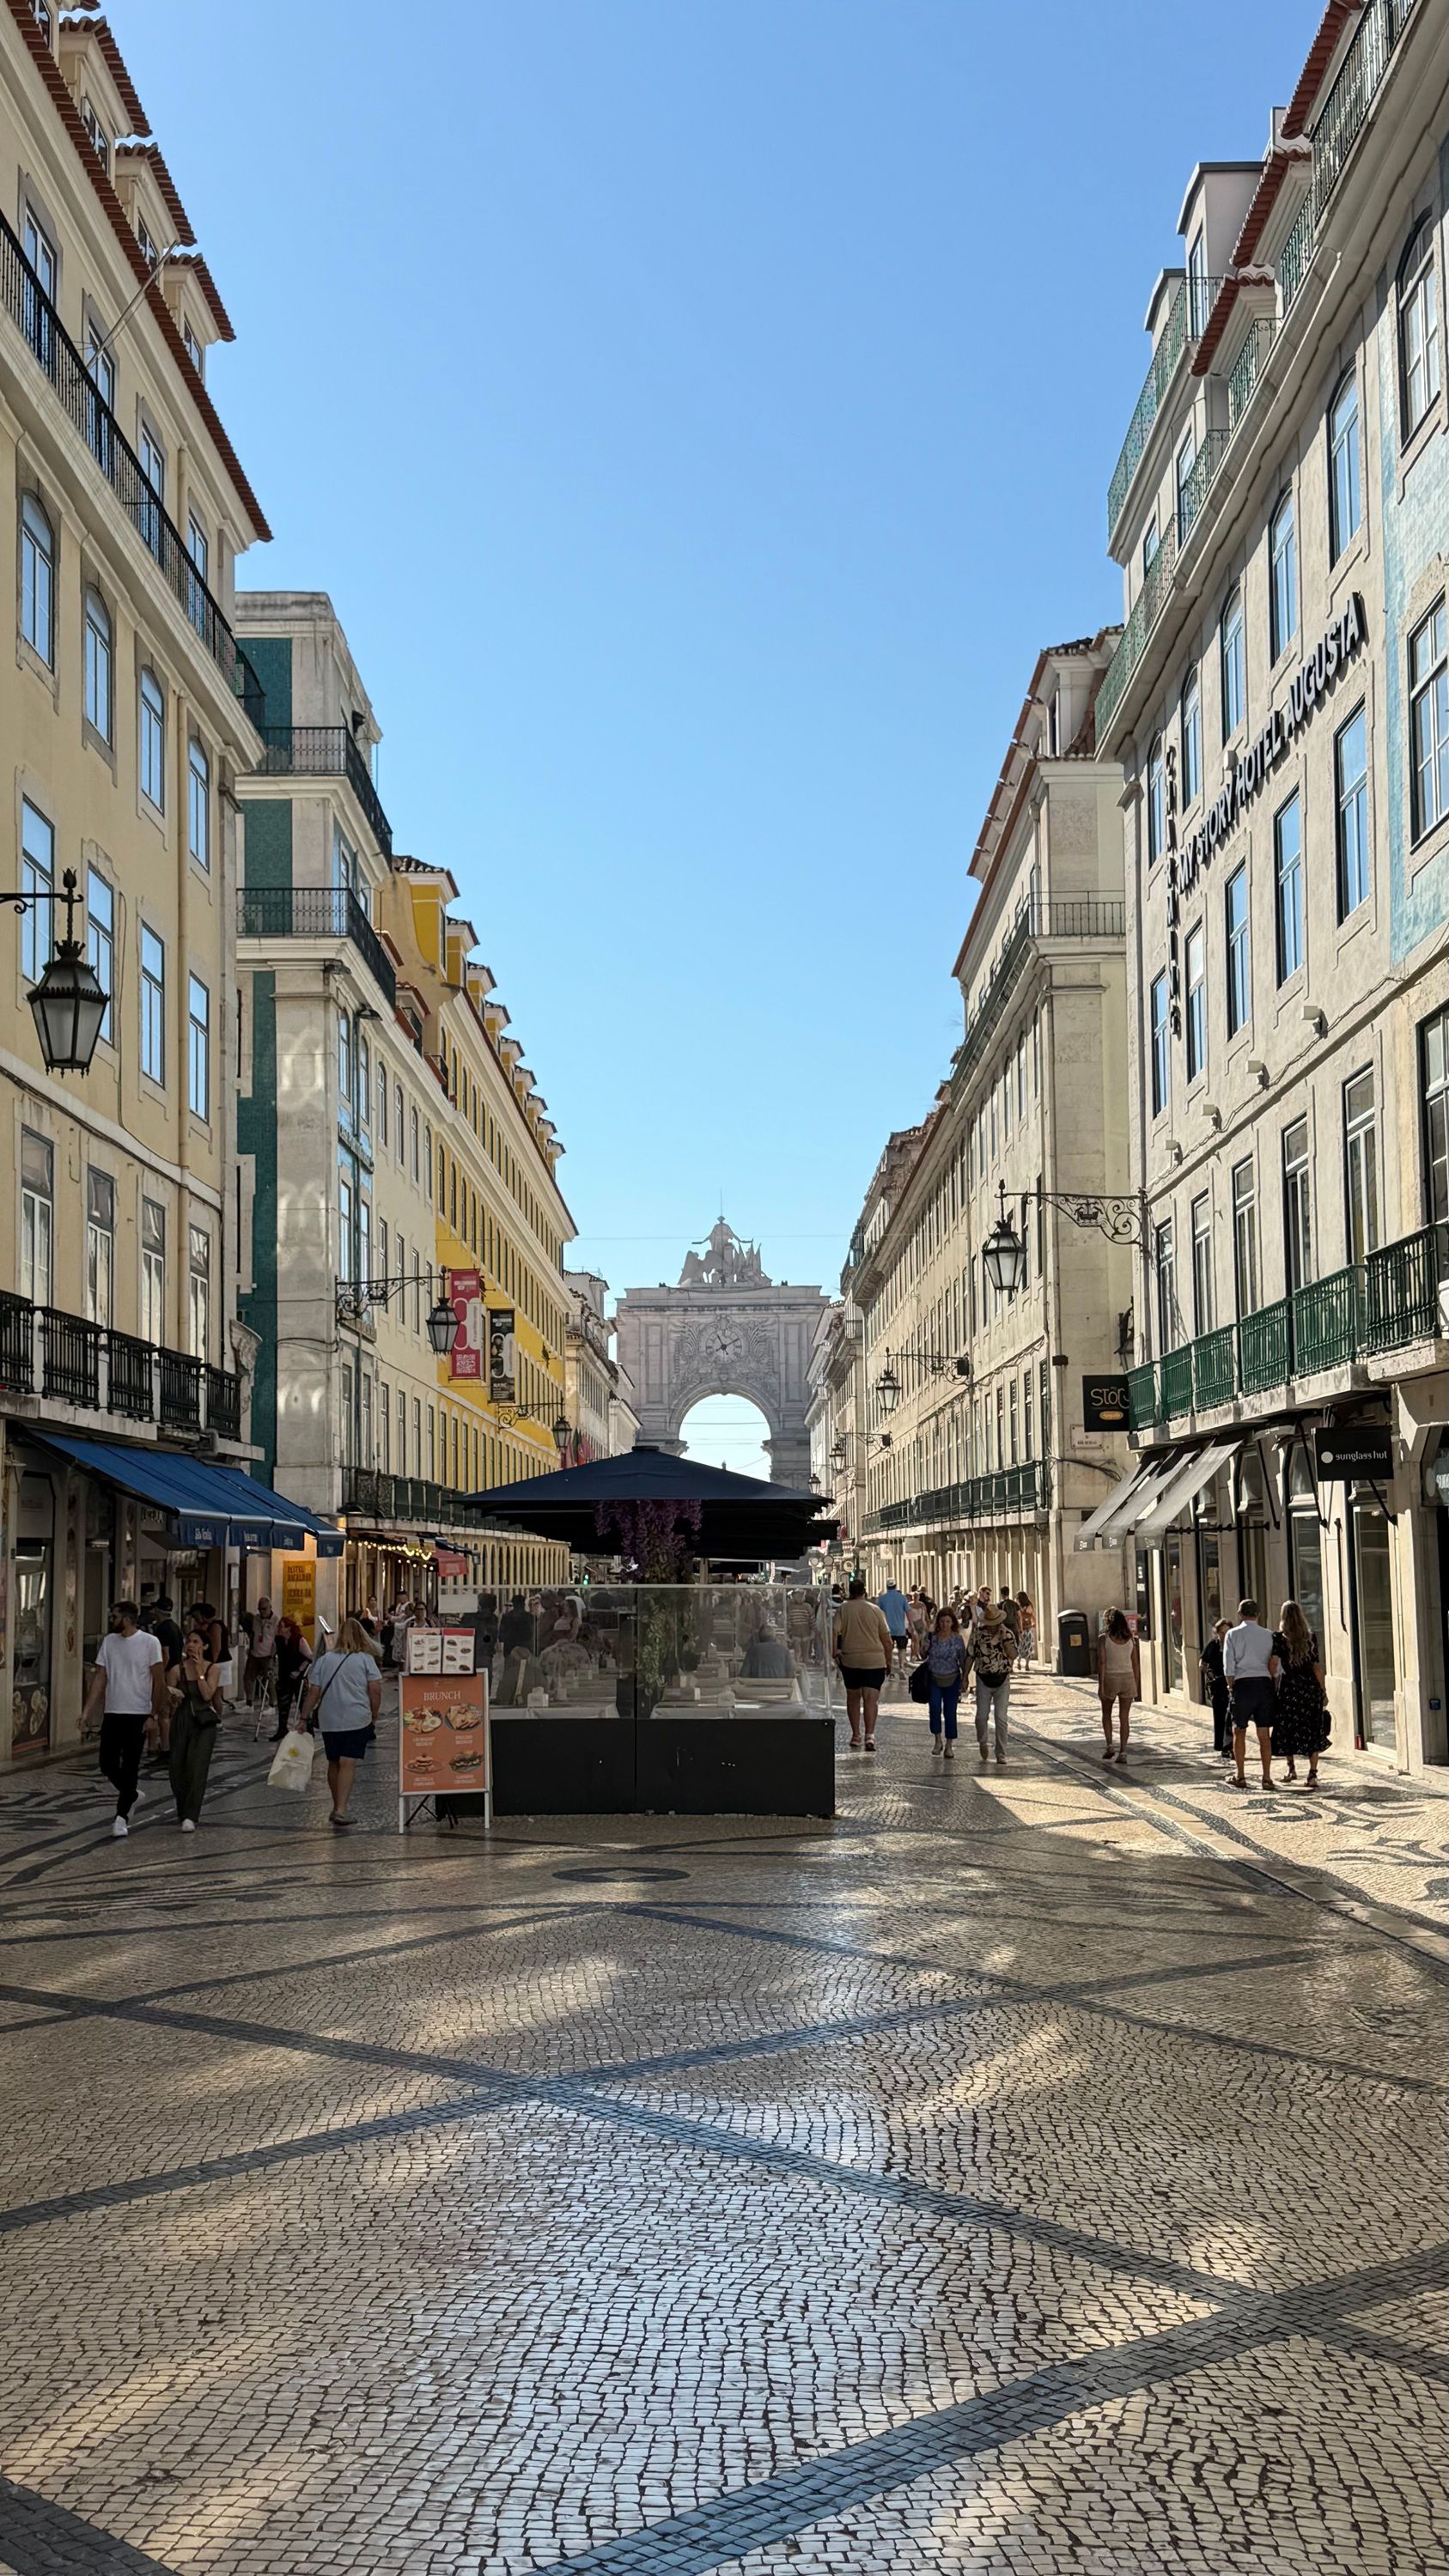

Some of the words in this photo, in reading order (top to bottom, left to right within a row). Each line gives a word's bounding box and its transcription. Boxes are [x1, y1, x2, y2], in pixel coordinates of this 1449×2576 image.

[1178, 835, 1196, 894] MY
[1196, 772, 1235, 865] STORY
[1237, 710, 1286, 808] HOTEL
[1284, 592, 1361, 741] AUGUSTA
[1166, 745, 1178, 1036] CHARMING
[1335, 1451, 1373, 1462] sunglass
[1373, 1450, 1388, 1459] hut
[423, 1691, 461, 1701] BRUNCH
